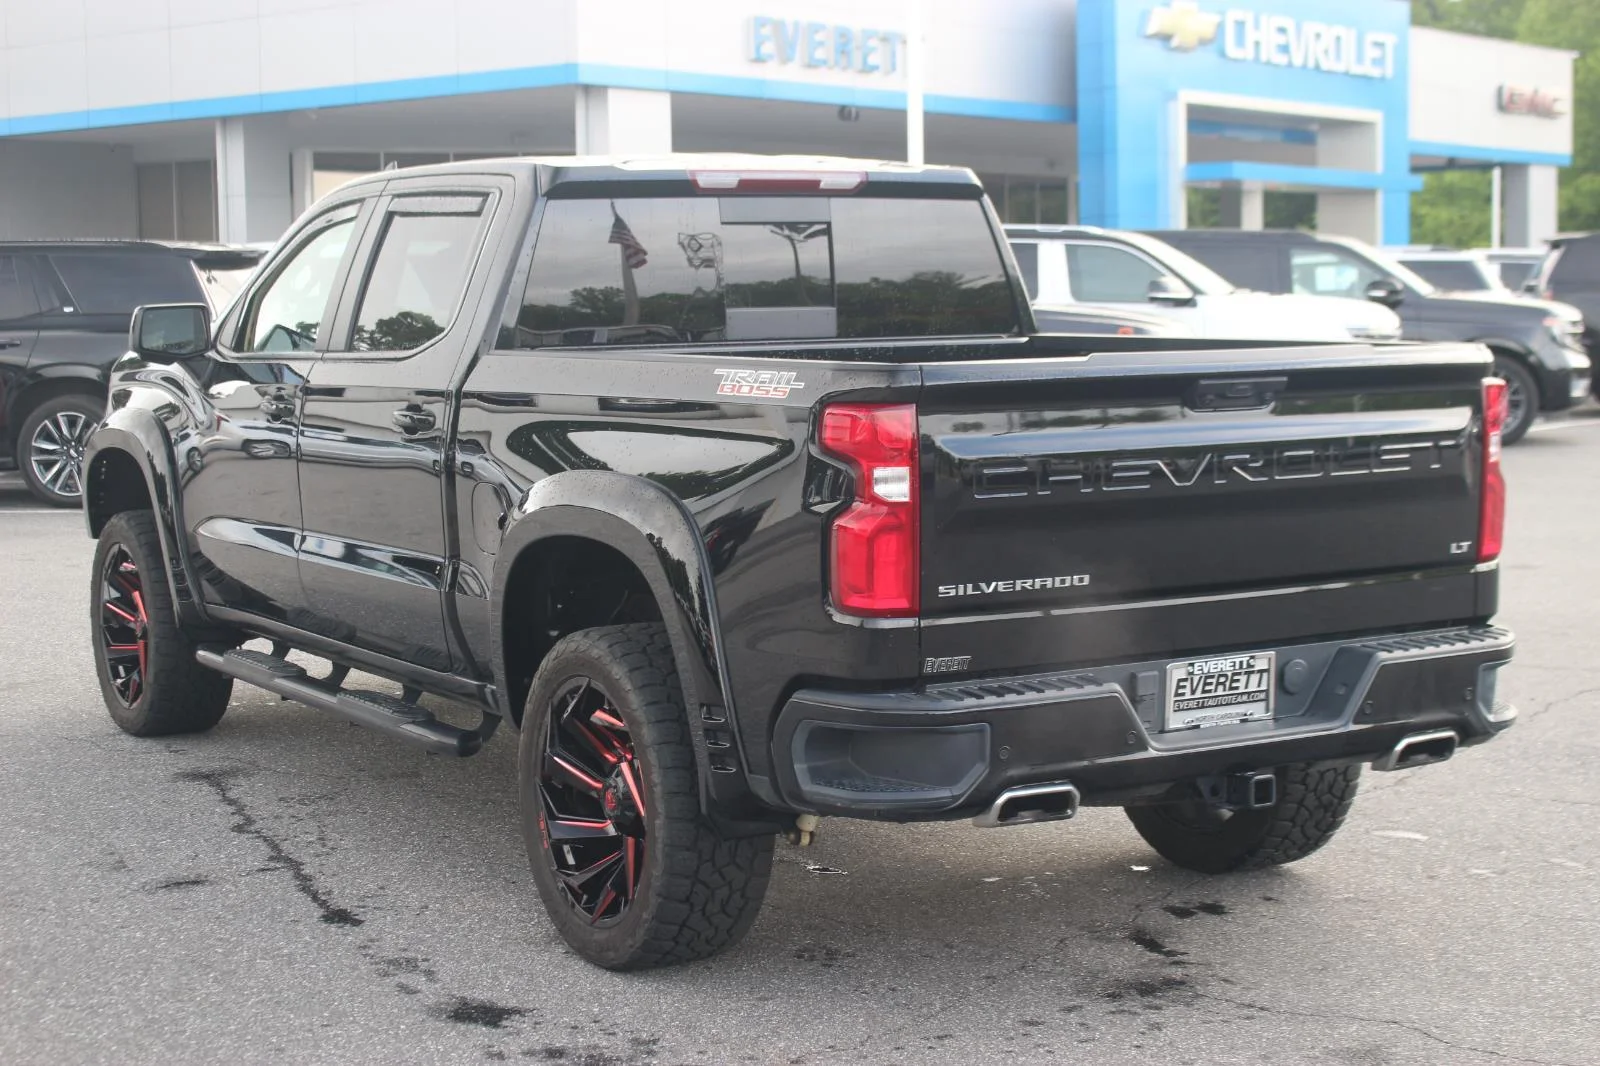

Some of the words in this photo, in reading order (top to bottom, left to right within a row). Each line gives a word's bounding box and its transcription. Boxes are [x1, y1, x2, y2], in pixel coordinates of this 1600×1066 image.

[748, 16, 908, 75] EVERET
[1224, 9, 1397, 79] CHEVROLET
[713, 368, 805, 389] TRAIL
[716, 383, 791, 399] BOSS
[973, 439, 1456, 499] CHEVROLET
[1450, 541, 1472, 554] LT
[937, 574, 1090, 598] SILVERADO
[923, 655, 972, 673] EVERETT
[1194, 656, 1250, 675] EVERETT
[1173, 668, 1269, 698] EVERETT
[1174, 692, 1267, 710] EVERETTAUTOTEAM.COM
